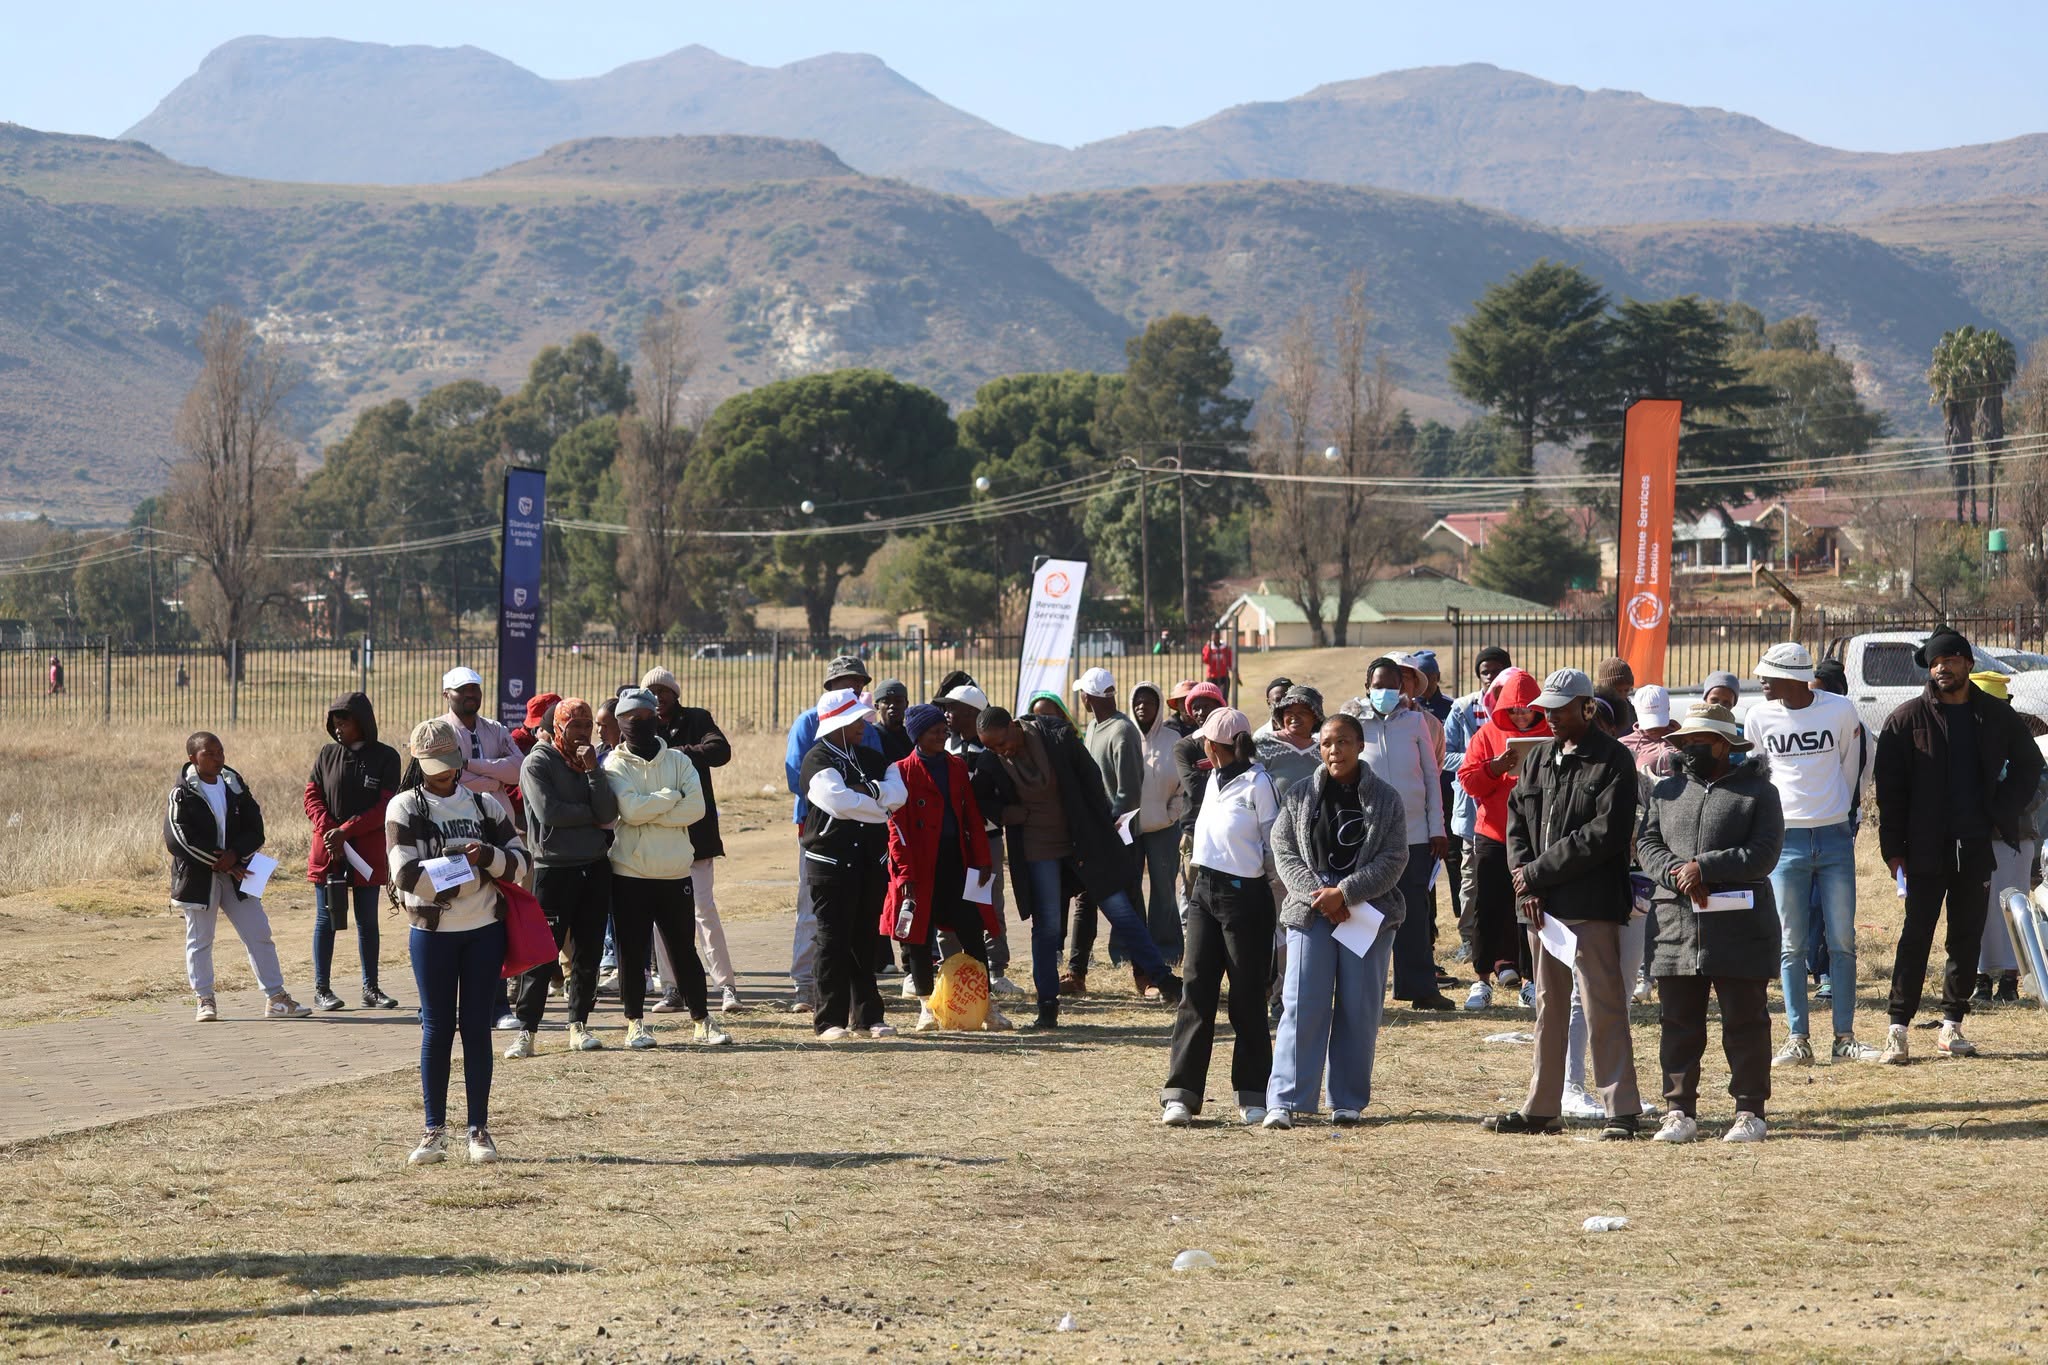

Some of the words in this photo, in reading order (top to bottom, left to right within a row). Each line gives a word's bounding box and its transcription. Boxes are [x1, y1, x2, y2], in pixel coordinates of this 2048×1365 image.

[1637, 475, 1651, 528] Services
[509, 519, 540, 530] Standard
[515, 538, 533, 547] Bank
[1634, 531, 1647, 584] Revenue
[1649, 543, 1659, 585] Lesotho
[1036, 601, 1072, 610] Revenue
[505, 610, 536, 621] Standard
[1033, 611, 1070, 621] Services
[506, 619, 533, 630] Lesotho
[510, 629, 526, 638] Bank
[1768, 730, 1834, 753] NASA
